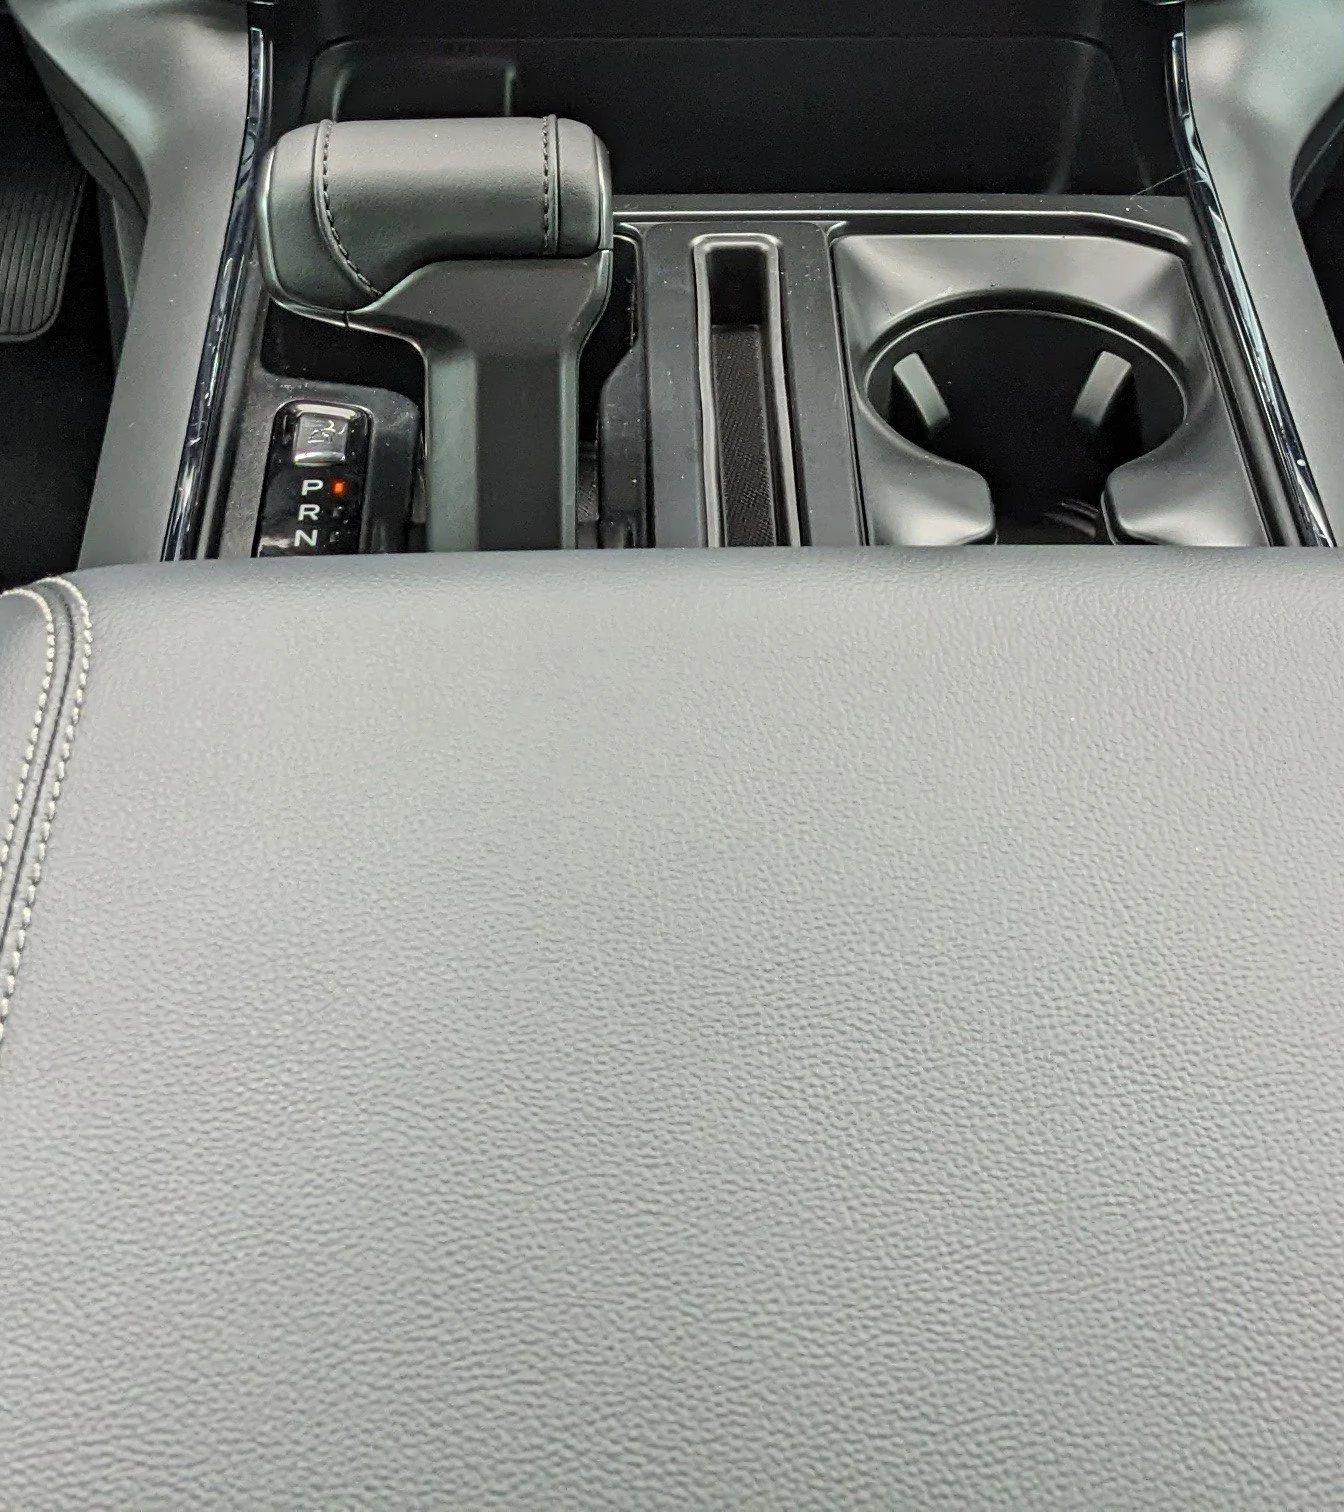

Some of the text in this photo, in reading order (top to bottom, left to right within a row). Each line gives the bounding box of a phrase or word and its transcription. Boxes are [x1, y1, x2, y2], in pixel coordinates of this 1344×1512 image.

[301, 479, 324, 496] P
[297, 503, 321, 521] R
[293, 529, 319, 547] N
